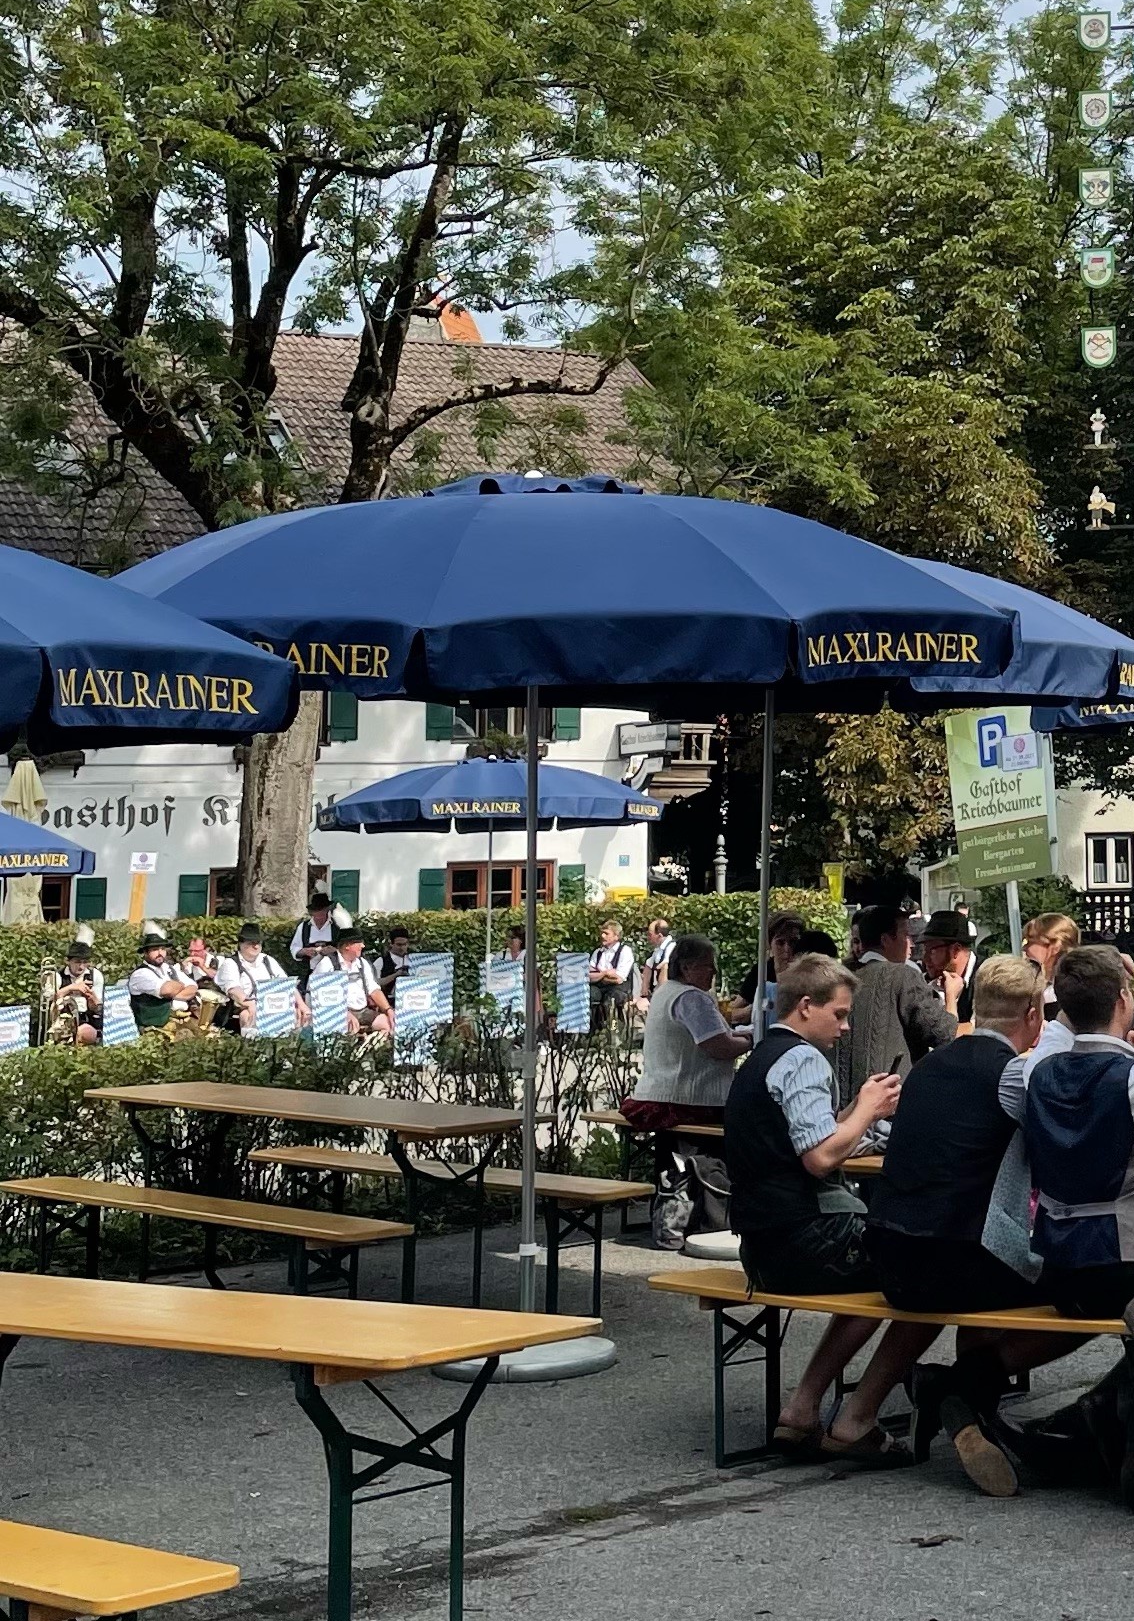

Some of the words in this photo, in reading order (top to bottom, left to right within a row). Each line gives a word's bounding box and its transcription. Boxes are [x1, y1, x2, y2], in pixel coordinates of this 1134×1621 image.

[807, 632, 982, 668] MAXLRAINER
[57, 667, 260, 715] MAXLRAINER
[431, 801, 521, 816] MAXLRAINER
[957, 795, 1043, 822] Kriechbaumer
[1018, 824, 1044, 839] Küche
[983, 847, 1025, 861] Biergarten
